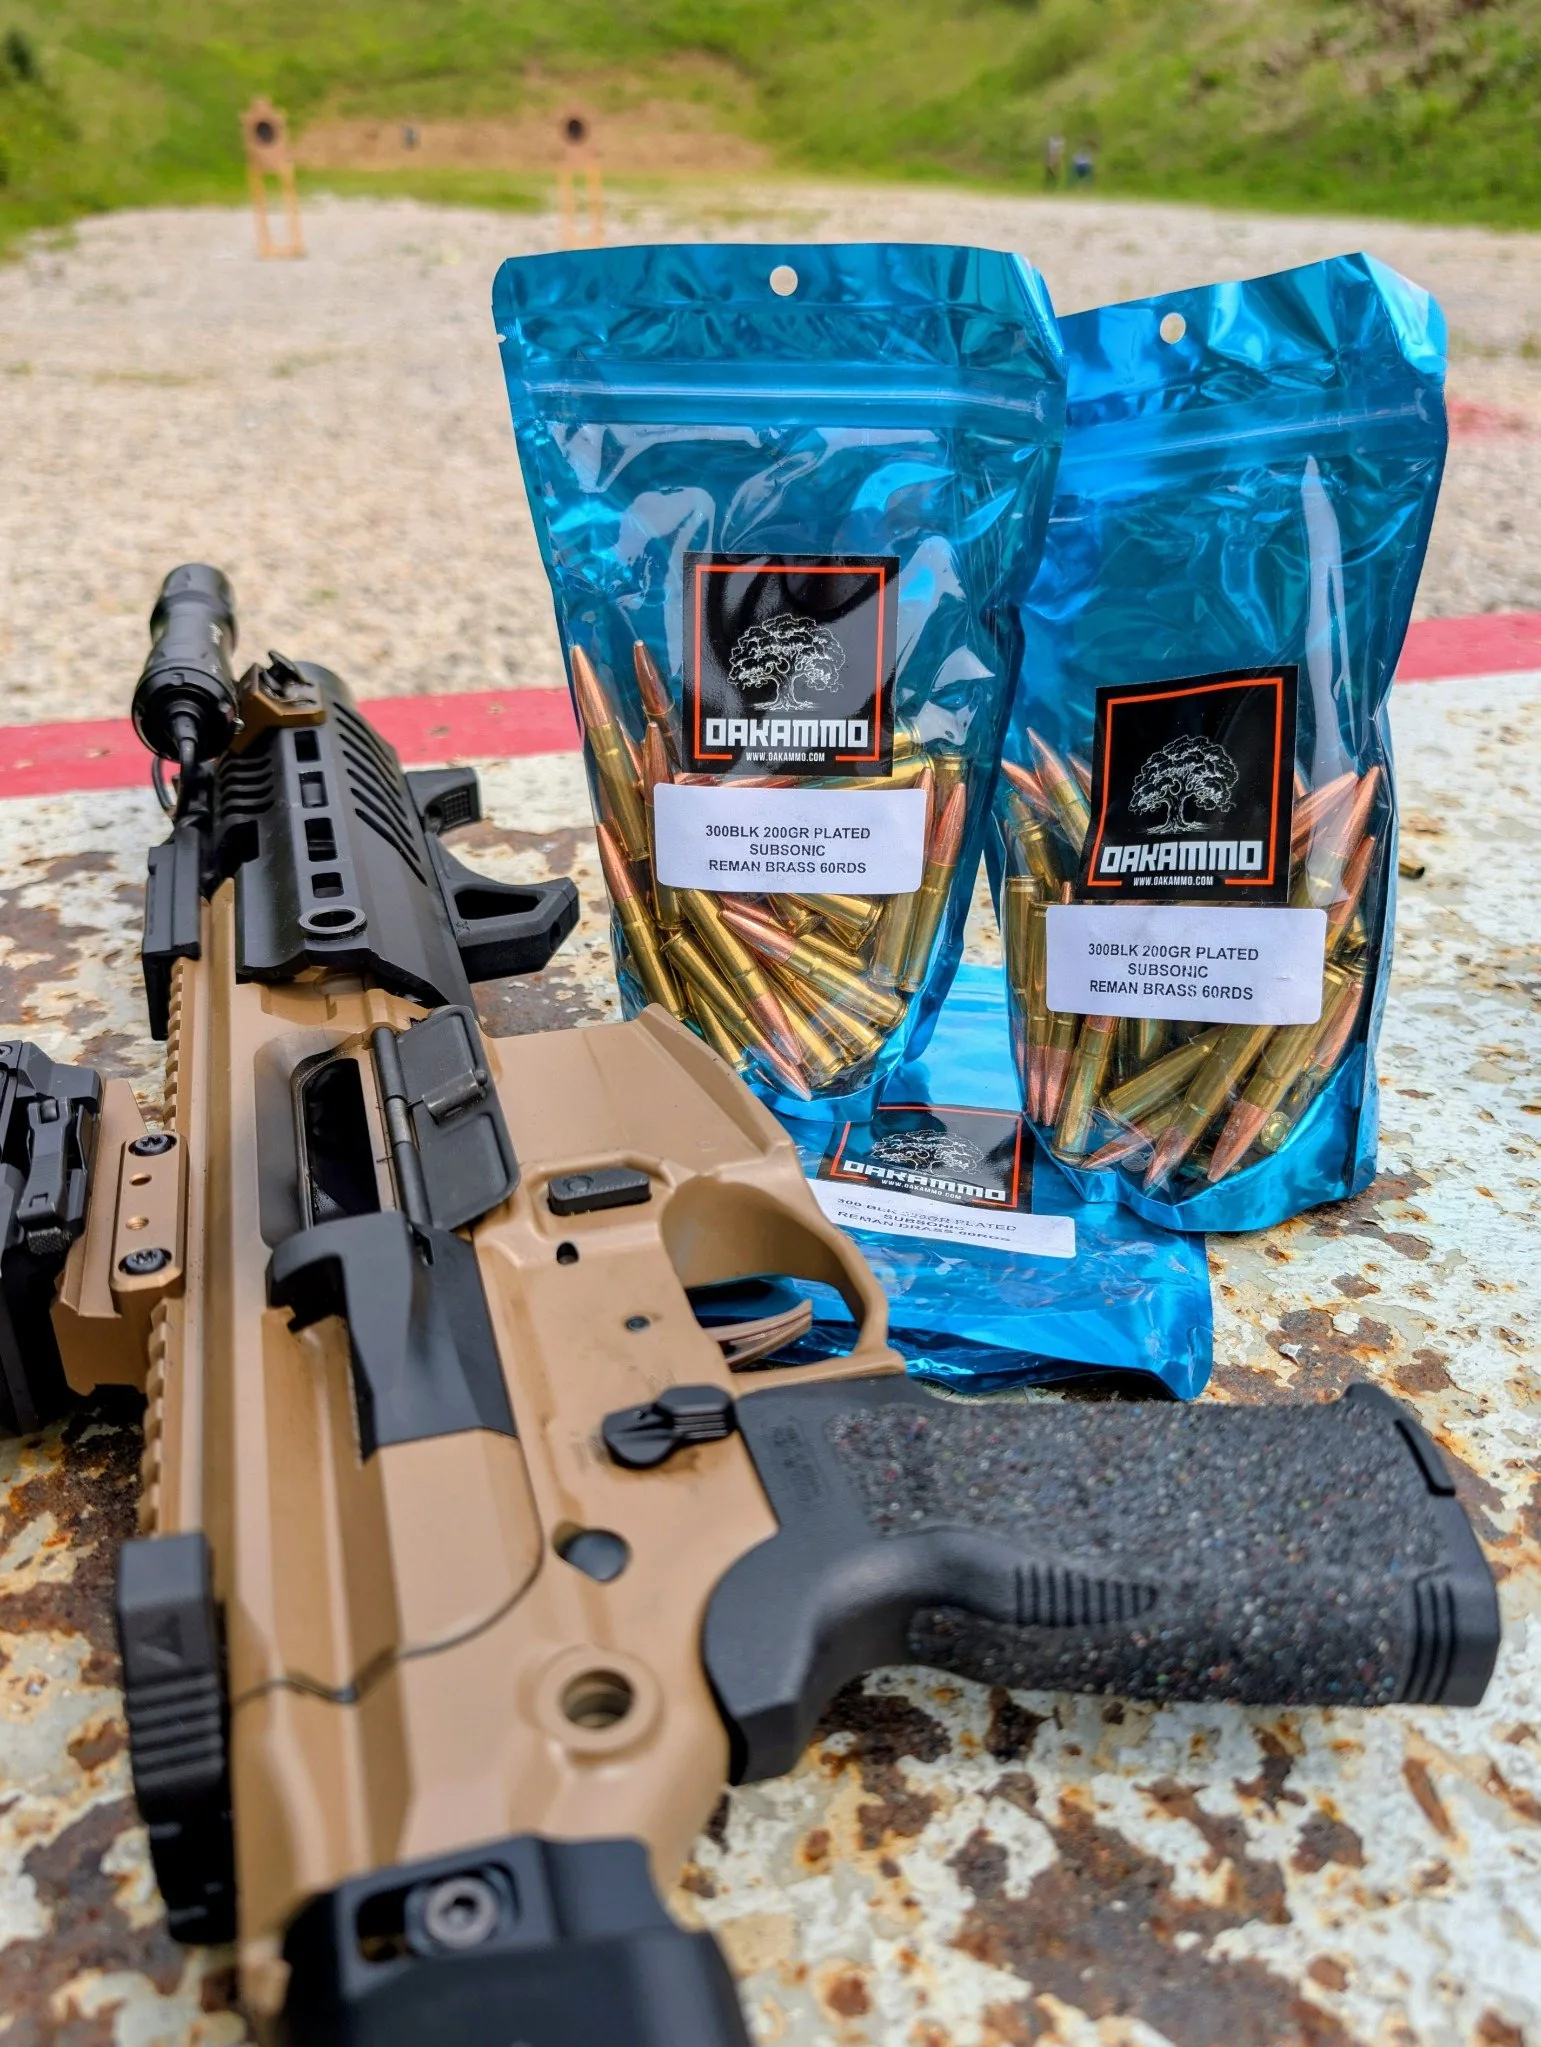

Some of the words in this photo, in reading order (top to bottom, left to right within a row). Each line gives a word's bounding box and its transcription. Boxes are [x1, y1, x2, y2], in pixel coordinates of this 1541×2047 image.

[705, 718, 869, 748] OAKAMMO
[746, 752, 825, 763] WWW.OAKAMMO.COM
[705, 825, 759, 838] 300BLK
[763, 826, 809, 839] 200GR
[814, 827, 871, 839] PLATED
[749, 843, 826, 857] SUBSONIC
[1099, 841, 1264, 873] OAKAMMO
[709, 859, 761, 872] REMAN
[765, 861, 816, 873] BRASS
[820, 862, 866, 874] 60RDS
[1133, 875, 1214, 887] WWW.OAKAMMO.COM
[1088, 943, 1139, 957] 300BLK
[1142, 945, 1191, 959] 200GR
[1196, 946, 1259, 961] PLATED
[1127, 962, 1208, 978] SUBSONIC
[1089, 980, 1138, 995] REMAN
[1143, 983, 1197, 998] BRASS
[1202, 985, 1253, 1000] 60RDS
[843, 1160, 1006, 1201] OAKAMMO
[881, 1178, 962, 1200] WWW.OAKAMMO.COM
[837, 1211, 894, 1228] REMAN
[883, 1214, 965, 1231] SUBSONIC
[954, 1219, 1017, 1232] PLATED
